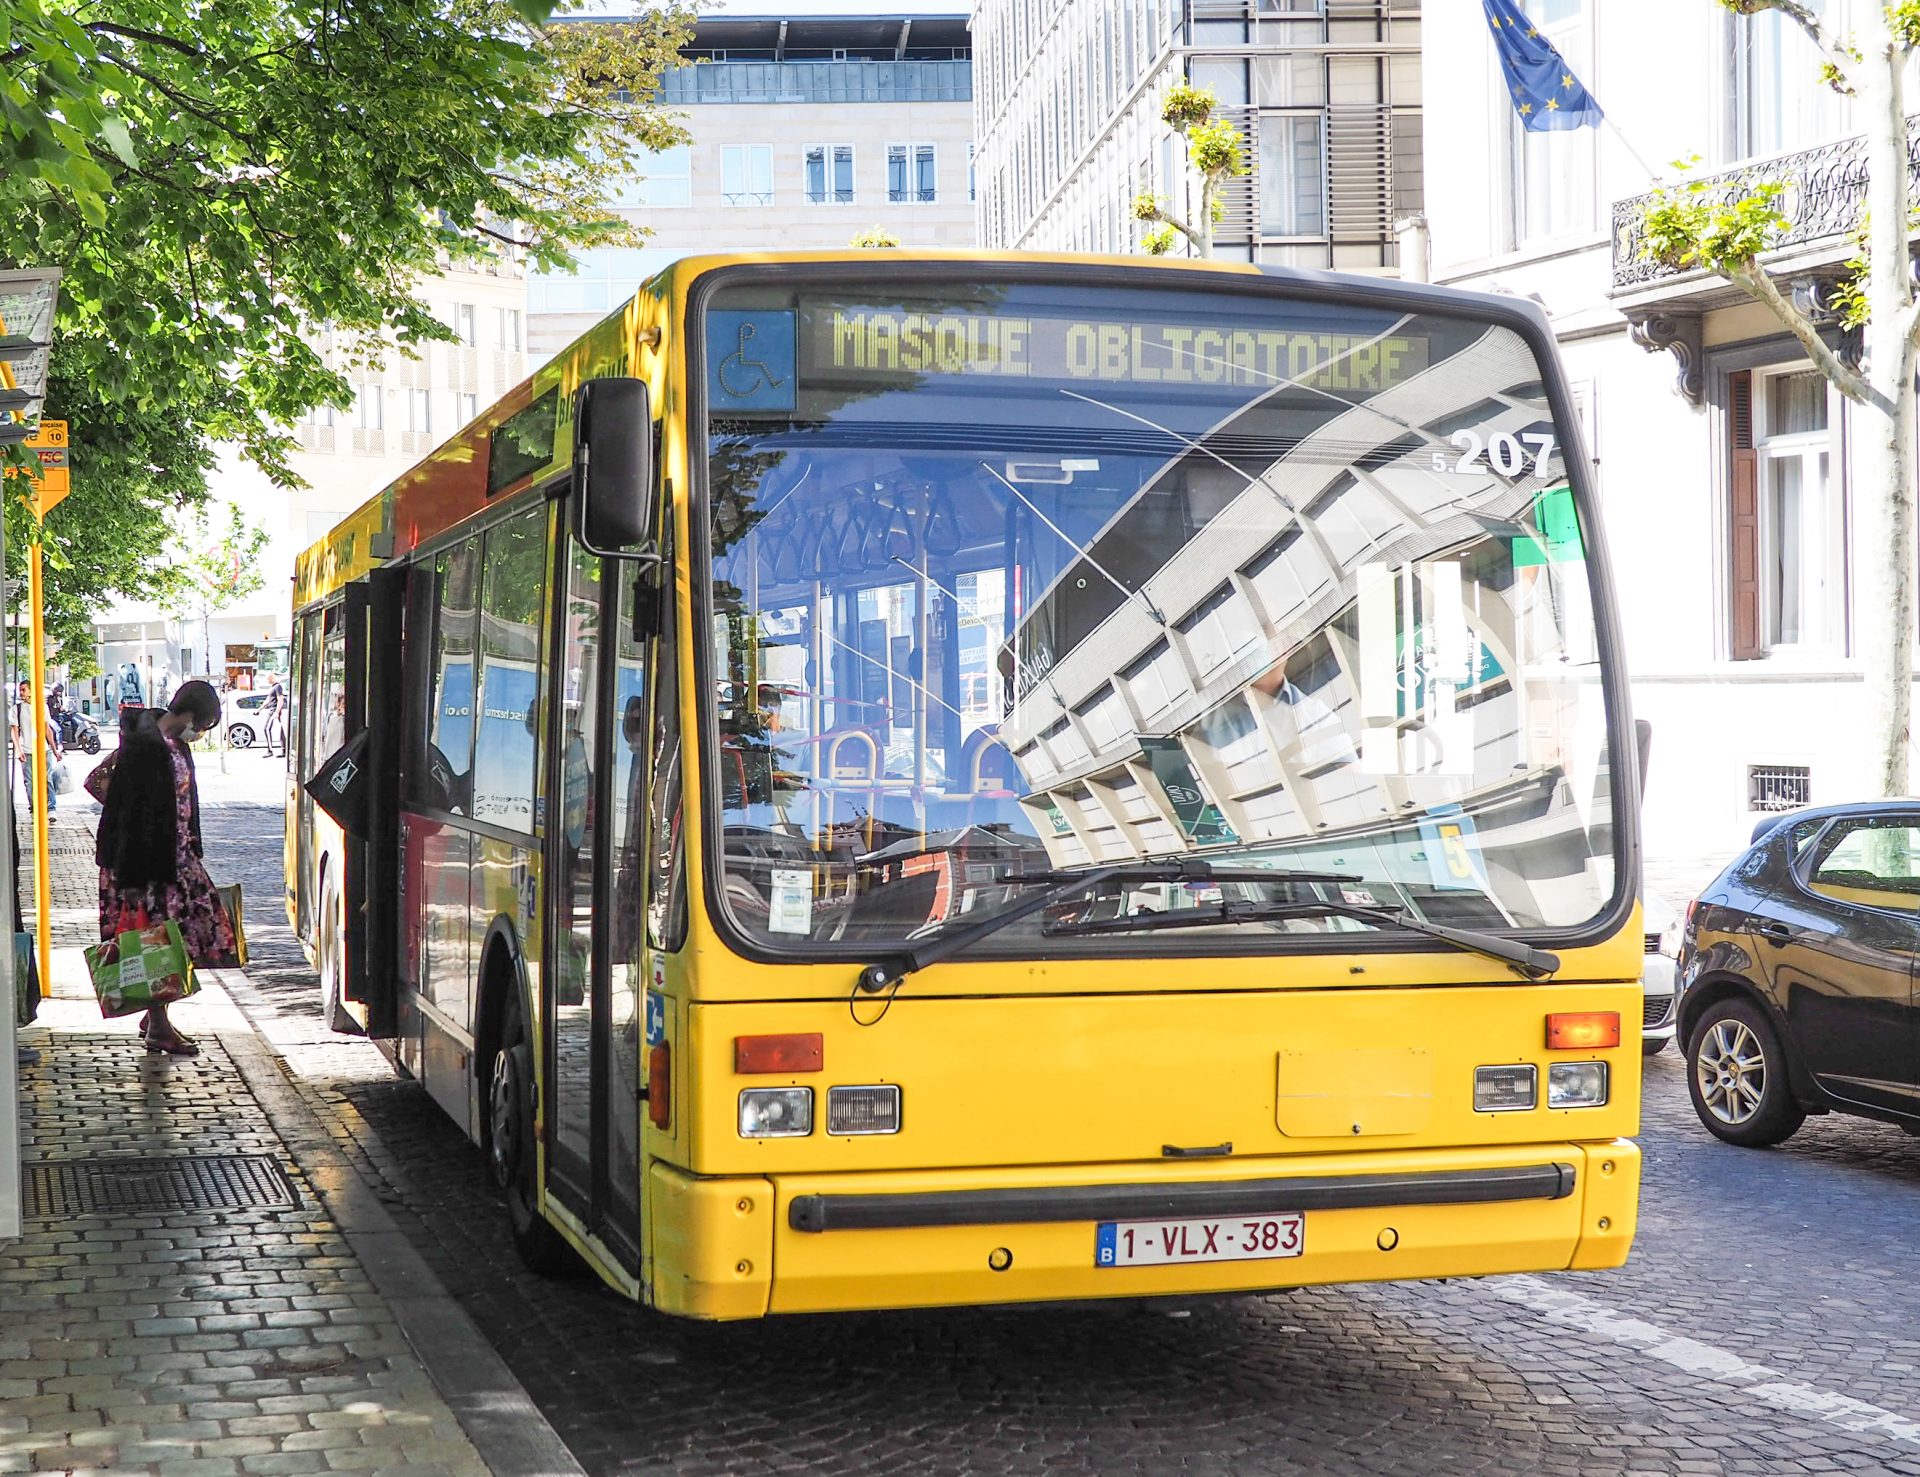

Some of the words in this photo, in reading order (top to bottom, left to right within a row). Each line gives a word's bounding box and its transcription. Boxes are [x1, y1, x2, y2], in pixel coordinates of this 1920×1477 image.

[833, 312, 1032, 374] MASQUE
[1066, 323, 1409, 390] OBLIGATOIRE
[38, 451, 64, 463] TEC
[50, 433, 61, 441] 10
[1439, 825, 1471, 878] 5
[1101, 1248, 1113, 1262] B
[1123, 1220, 1300, 1259] 1-VLX-383
